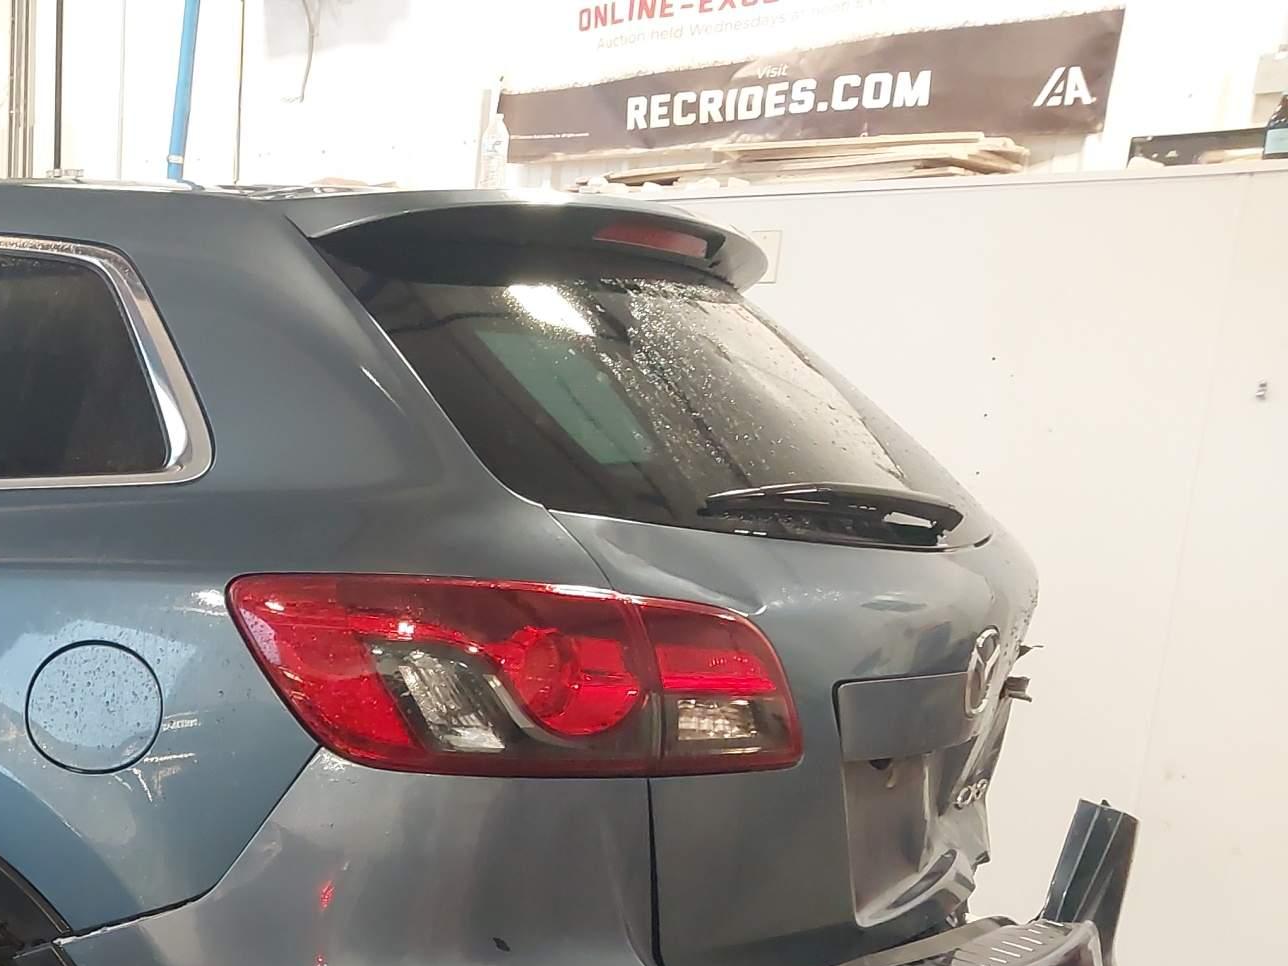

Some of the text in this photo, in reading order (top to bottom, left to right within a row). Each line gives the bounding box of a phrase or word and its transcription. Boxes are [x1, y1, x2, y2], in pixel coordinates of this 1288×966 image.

[597, 32, 646, 49] Auction
[650, 25, 683, 41] held
[689, 14, 786, 37] Wednesdays
[756, 64, 789, 79] Visit
[626, 70, 933, 131] RECRIDES.COM
